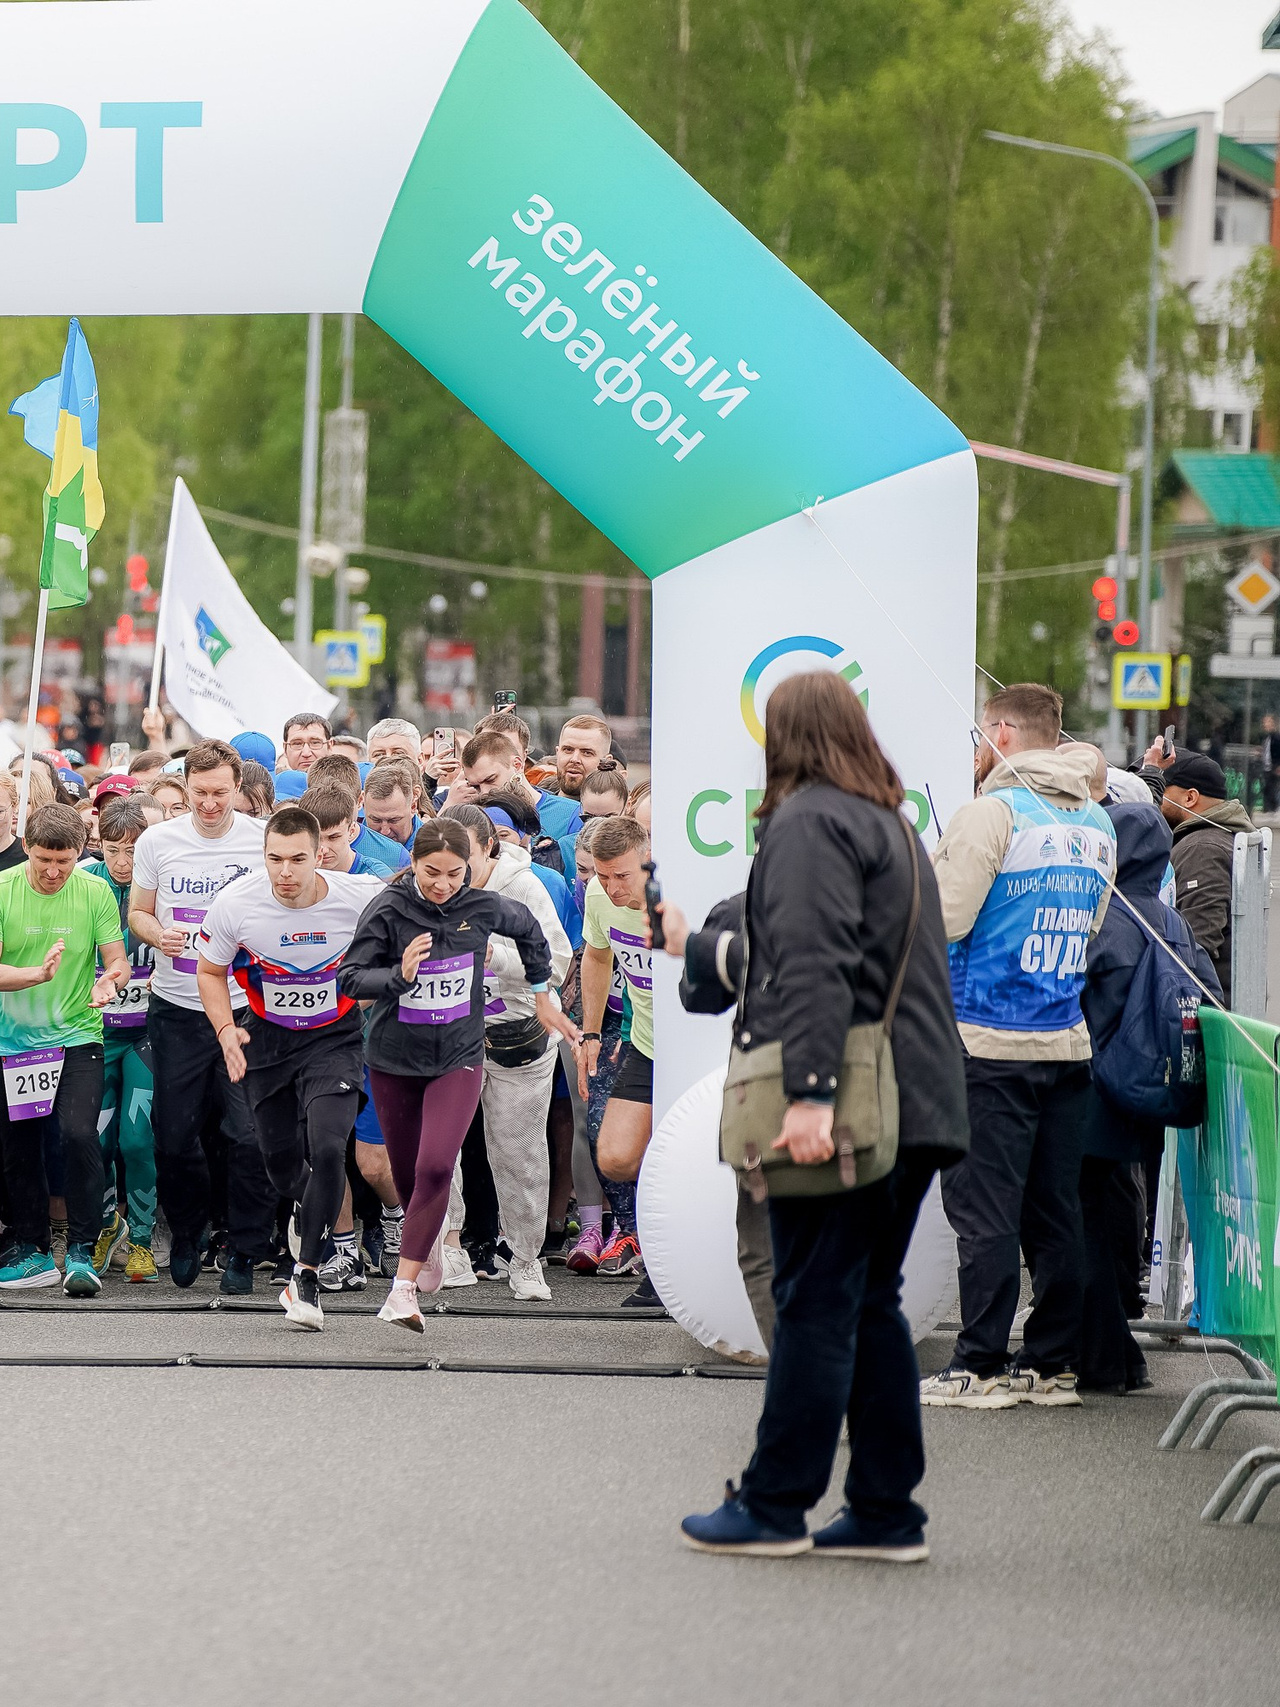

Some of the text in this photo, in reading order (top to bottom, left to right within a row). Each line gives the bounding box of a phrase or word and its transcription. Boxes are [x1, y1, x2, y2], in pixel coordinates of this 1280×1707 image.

[512, 194, 761, 419] зелёный
[467, 236, 706, 462] марафон
[171, 877, 218, 893] Utair
[274, 990, 328, 1008] 2289
[410, 978, 466, 999] 2152
[16, 1070, 59, 1094] 2185
